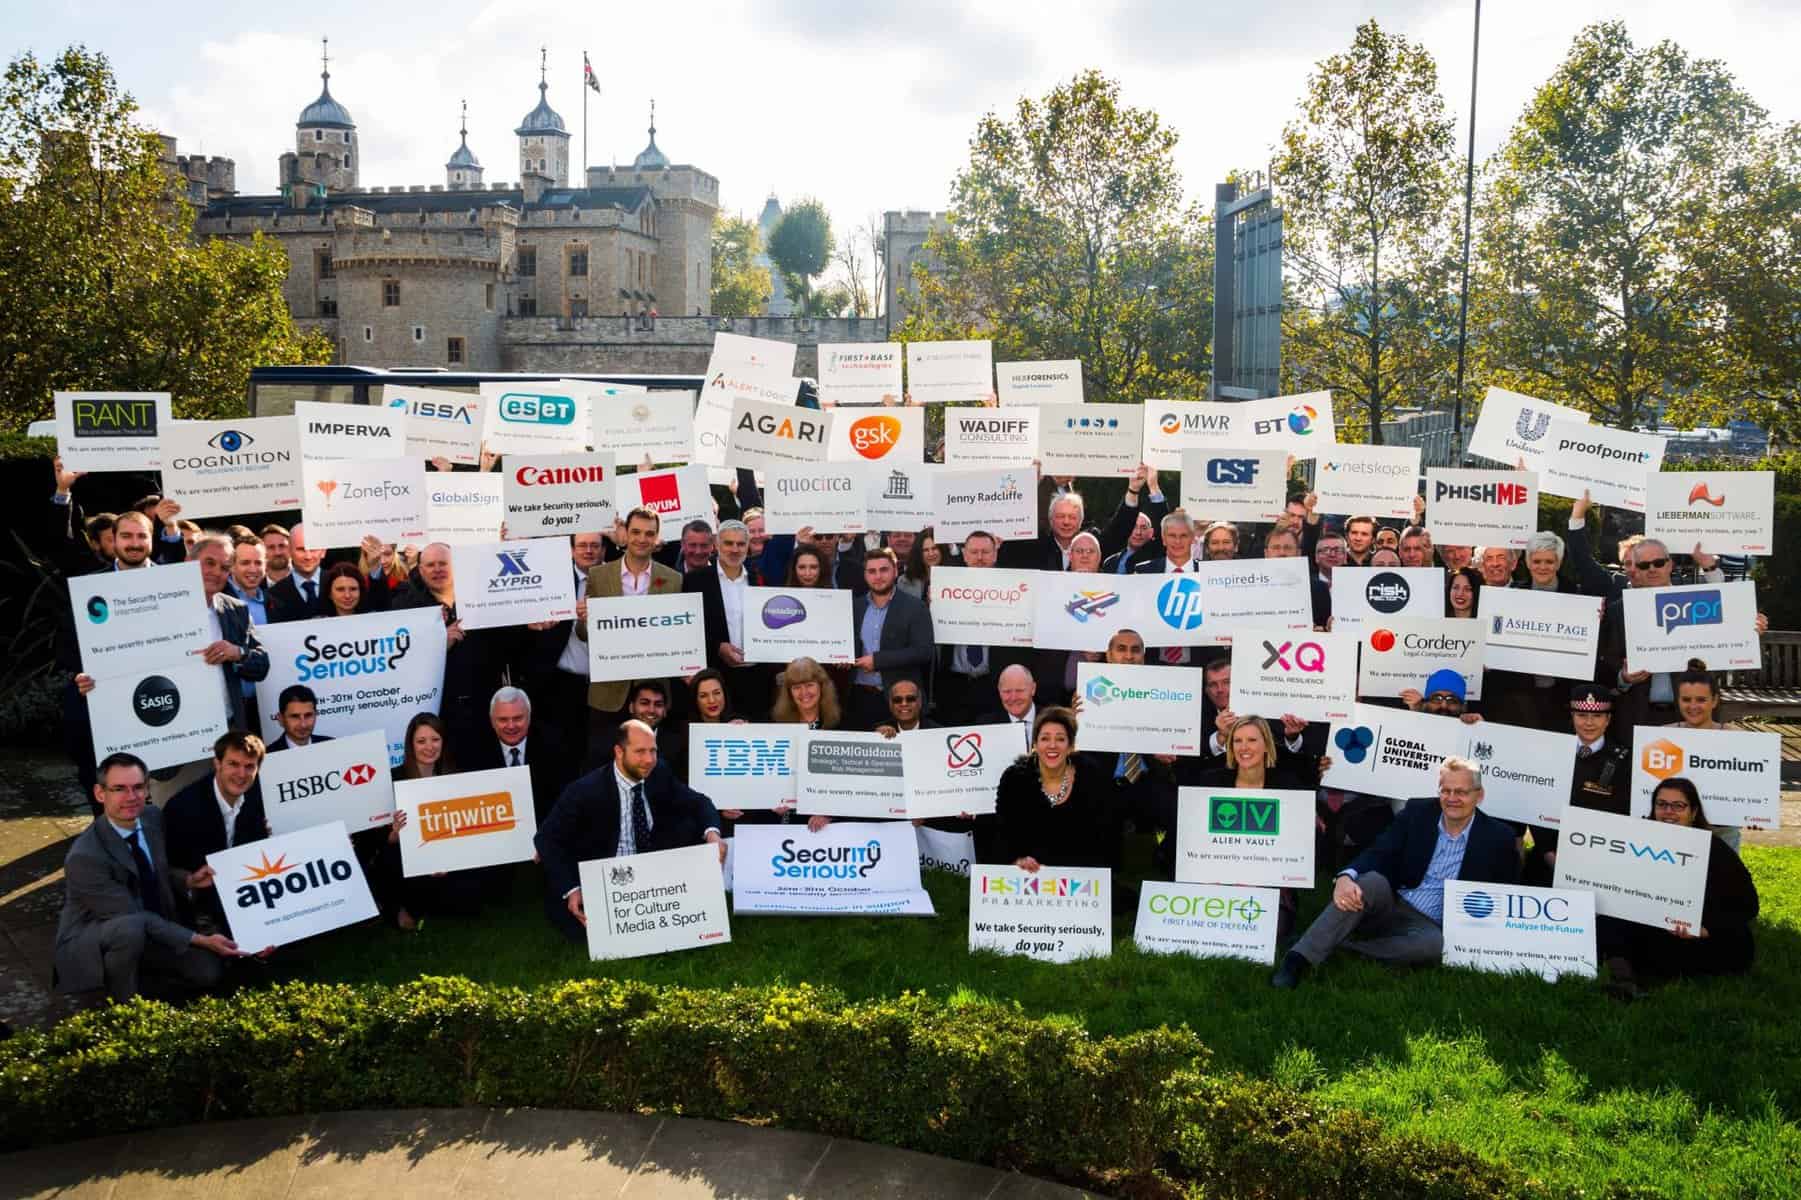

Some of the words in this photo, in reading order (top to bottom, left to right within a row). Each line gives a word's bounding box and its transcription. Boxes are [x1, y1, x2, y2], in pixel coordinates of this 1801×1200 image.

[76, 402, 152, 427] RANT
[413, 401, 472, 425] ISSA
[1184, 414, 1230, 431] MWR
[309, 422, 391, 437] IMPERVA
[737, 411, 824, 443] AGARI
[855, 422, 894, 450] gsk
[960, 420, 1029, 433] WADIFF
[1255, 418, 1286, 435] BT
[960, 433, 1028, 442] CONSULTING
[173, 450, 291, 471] COGNITION
[1559, 439, 1644, 464] proofpoint
[515, 466, 604, 486] Canon
[1207, 458, 1260, 485] CSF
[1343, 459, 1411, 478] netskope
[343, 481, 410, 501] ZoneFox
[777, 477, 851, 496] quocirca
[432, 492, 500, 505] GlobalSign
[508, 501, 523, 514] We
[524, 500, 541, 513] take
[543, 499, 574, 513] Security
[946, 494, 976, 506] Jenny
[978, 491, 1023, 502] Radcliffe
[542, 514, 555, 526] do
[557, 516, 573, 527] you
[487, 574, 542, 589] XYPRO
[113, 598, 126, 607] The
[127, 593, 157, 606] Security
[159, 588, 190, 603] Company
[941, 586, 1021, 605] nccgroup
[1166, 580, 1200, 630] hp
[597, 611, 693, 631] mimecast
[1662, 600, 1721, 625] prpr
[1556, 622, 1589, 637] PAGE
[1404, 633, 1472, 660] Cordery
[1261, 640, 1326, 673] XQ
[139, 694, 174, 710] SASIG
[1111, 686, 1193, 703] CyberSolace
[1385, 737, 1426, 752] GLOBAL
[704, 740, 791, 775] IBM
[1382, 755, 1430, 772] SYSTEMS
[1384, 746, 1446, 764] UNIVERSITY
[1648, 746, 1677, 769] Br
[1690, 755, 1764, 774] Bromium
[1492, 765, 1555, 789] Government
[277, 772, 341, 803] HSBC
[422, 801, 511, 834] tripwire
[1212, 836, 1241, 845] ALIEN
[1245, 838, 1276, 846] VAULT
[1569, 831, 1695, 867] OPSWAT
[235, 858, 353, 910] apollo
[612, 881, 687, 907] Department
[613, 904, 632, 920] for
[634, 899, 681, 917] Culture
[1013, 898, 1101, 910] MARKETING
[1148, 894, 1262, 921] corero
[1505, 894, 1569, 923] IDC
[616, 918, 656, 936] Media
[659, 915, 669, 929] &
[671, 910, 708, 928] Sport
[975, 921, 992, 934] We
[994, 921, 1015, 934] take
[1017, 922, 1056, 939] Security
[1058, 924, 1105, 940] seriously,
[1162, 917, 1186, 926] FIRST
[1188, 918, 1205, 927] LINE
[1206, 919, 1217, 928] OF
[1505, 920, 1539, 933] Analyze
[1541, 921, 1554, 932] the
[1556, 922, 1584, 934] Future
[1015, 938, 1030, 952] do
[1032, 941, 1055, 956] you
[1057, 939, 1064, 952] ?
